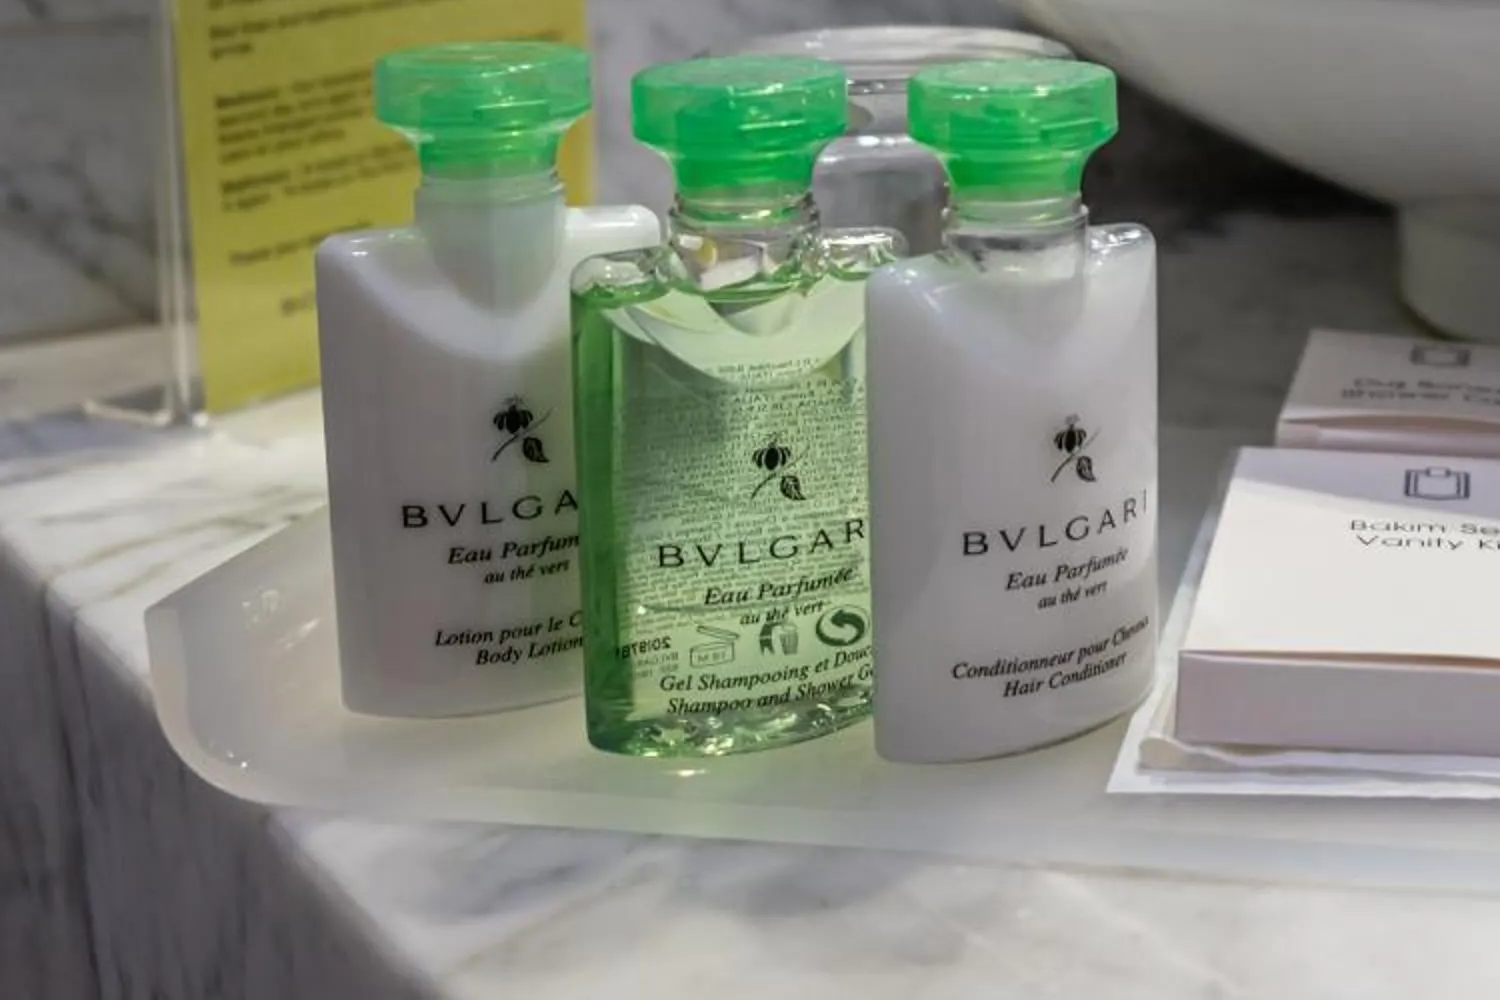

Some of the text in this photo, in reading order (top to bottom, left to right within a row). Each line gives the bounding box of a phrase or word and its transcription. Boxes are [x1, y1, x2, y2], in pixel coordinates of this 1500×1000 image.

[401, 489, 579, 528] BVLGA
[962, 488, 1147, 556] BVLGARI
[447, 533, 580, 565] Eau Parfum
[658, 518, 865, 568] BVLGAR
[1356, 535, 1464, 551] Vanity
[483, 559, 570, 585] au thé vert
[704, 566, 858, 606] Eau Parfumée
[1004, 571, 1047, 591] Eau
[739, 601, 824, 626] au thé vert
[1037, 594, 1056, 610] au
[1060, 586, 1081, 603] thé
[435, 629, 494, 647] Lotion
[500, 623, 543, 644] pour
[548, 617, 563, 633] le
[475, 636, 584, 666] Body Lotion
[951, 650, 1075, 680] Conditionneur
[1077, 639, 1110, 664] pour
[659, 674, 694, 693] Gel
[698, 661, 809, 692] Shampooing
[814, 658, 830, 673] et
[1002, 652, 1127, 698] Hair Conditioner
[667, 693, 752, 715] Shampoo
[757, 688, 794, 709] and
